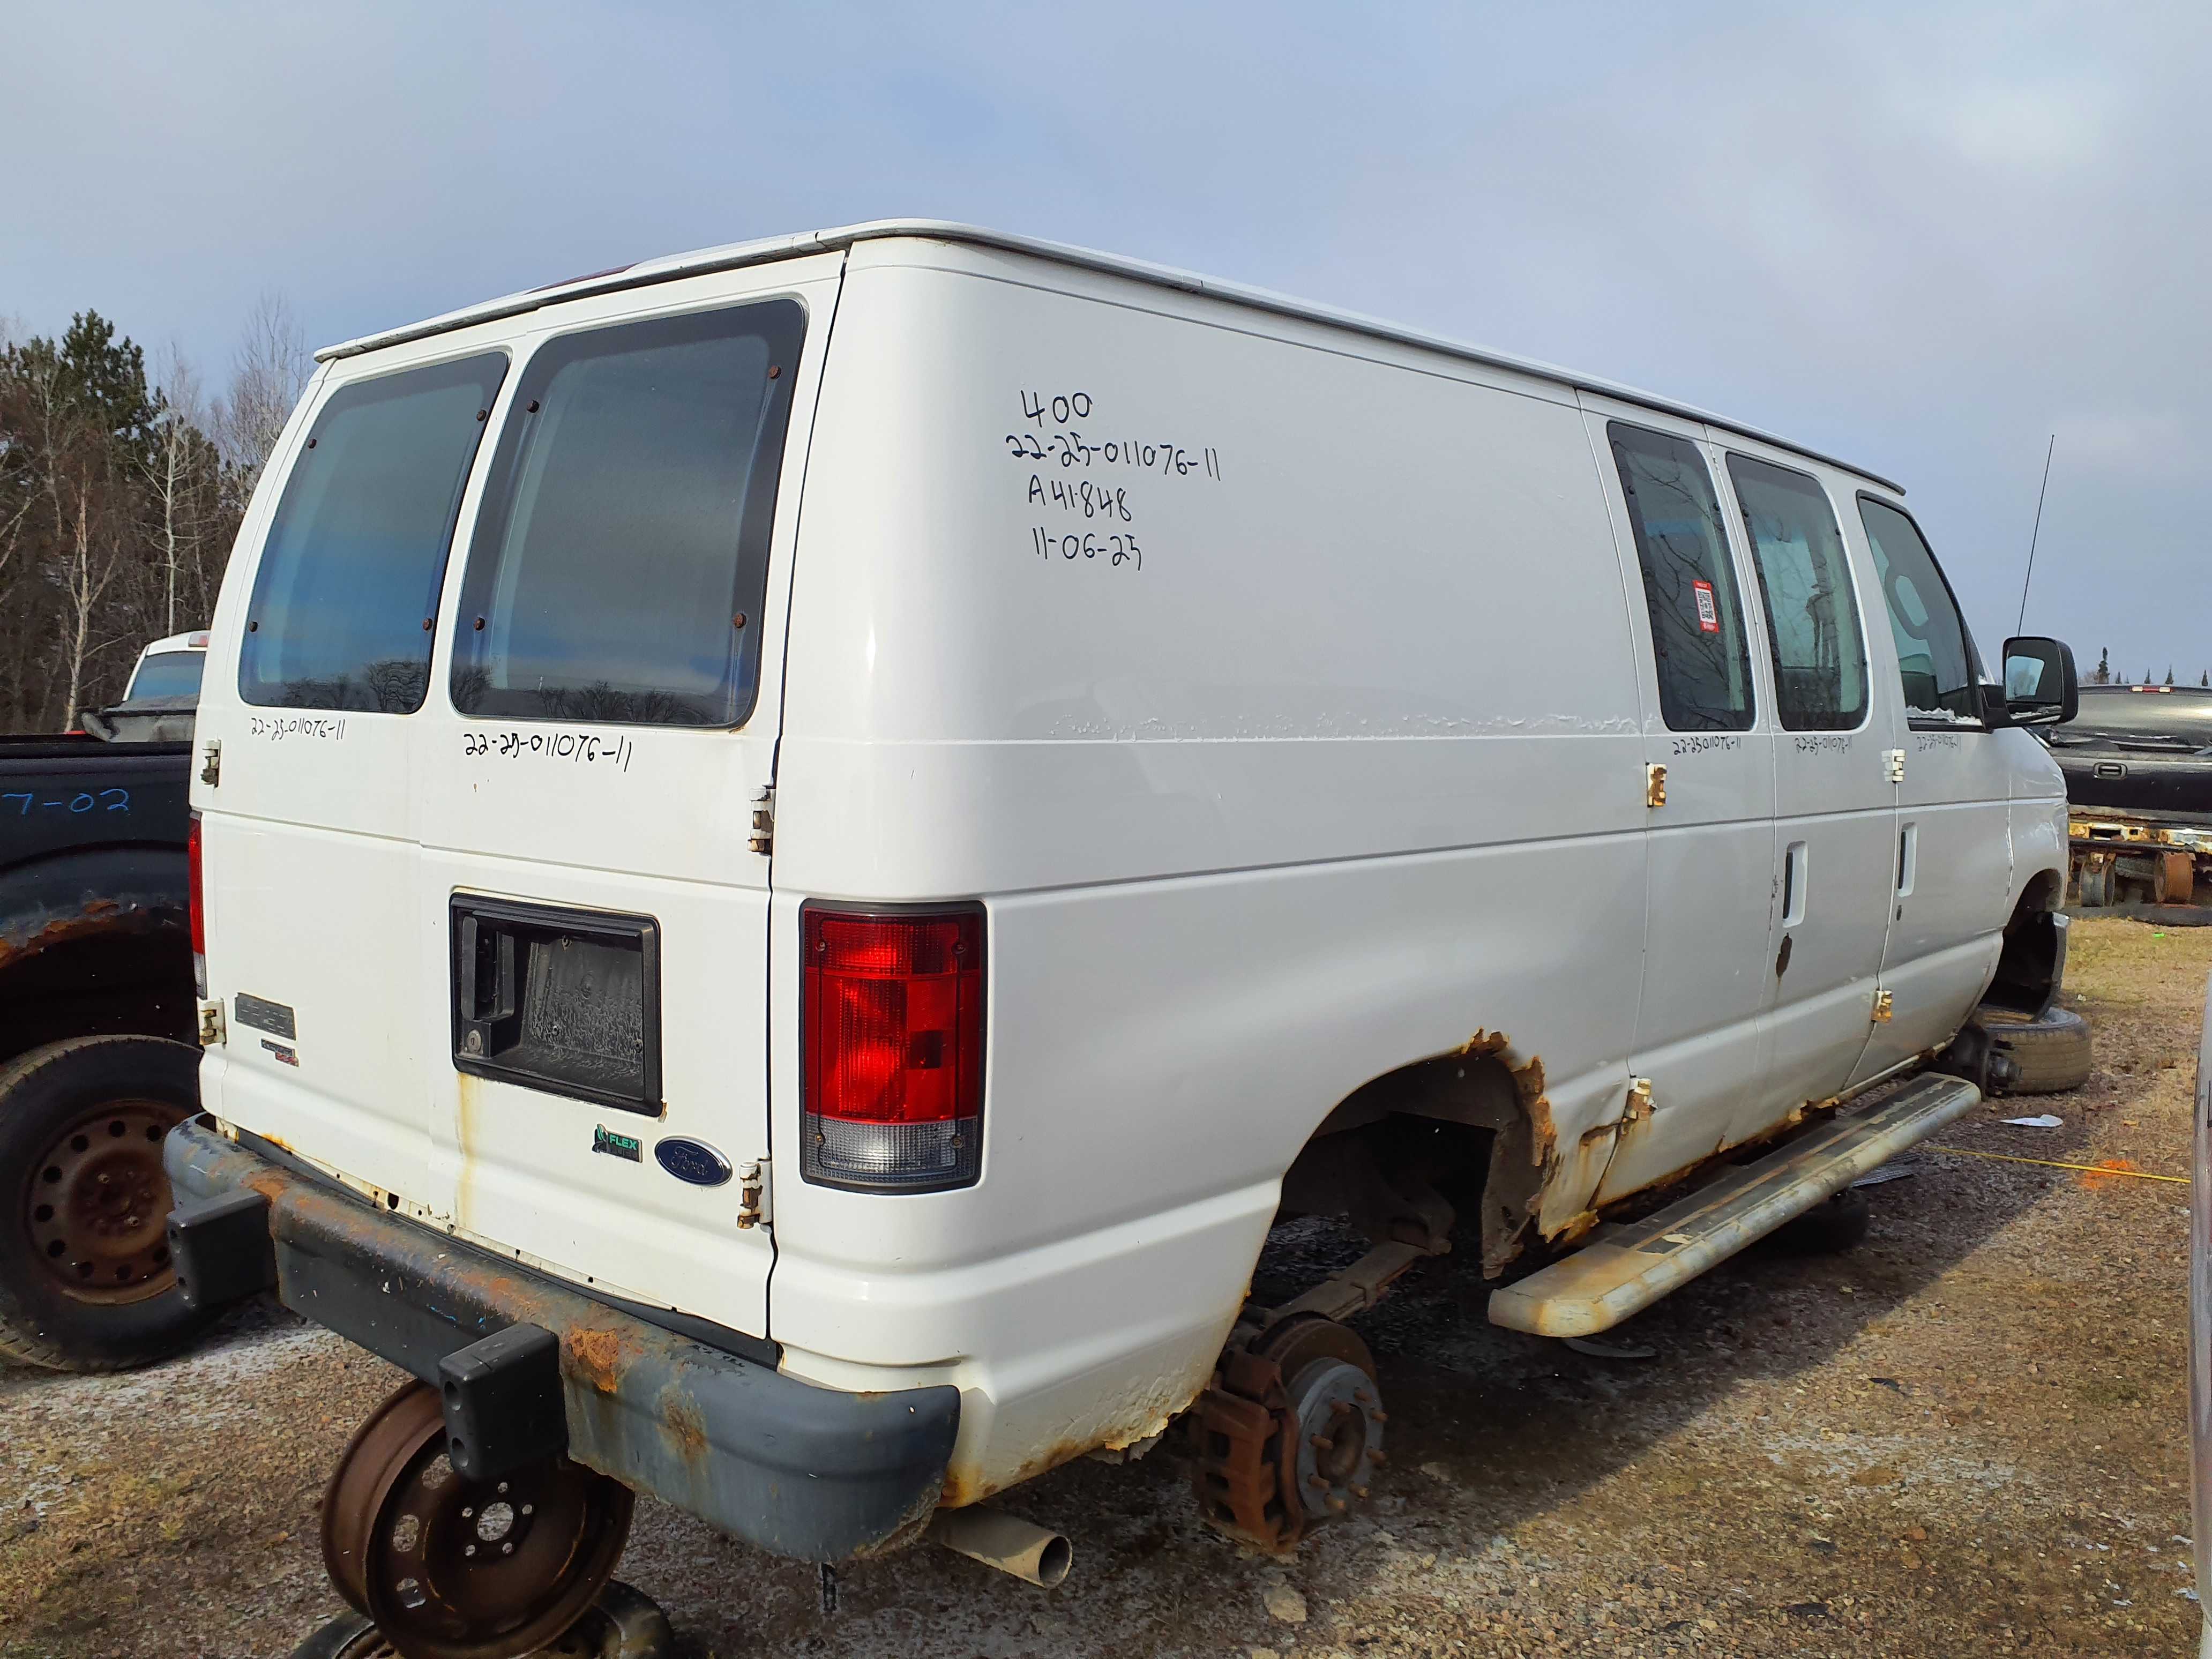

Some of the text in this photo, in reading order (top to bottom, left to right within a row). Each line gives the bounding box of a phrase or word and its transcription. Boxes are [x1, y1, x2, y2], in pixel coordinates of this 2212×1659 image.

[1020, 390, 1093, 428] 400
[1005, 431, 1222, 482] 22-25-011076-11
[1032, 526, 1142, 572] 11-06-25
[251, 717, 346, 741] 22-25-011076-11
[463, 732, 632, 773] 22-25-011076-11
[609, 1133, 638, 1151] FLEX
